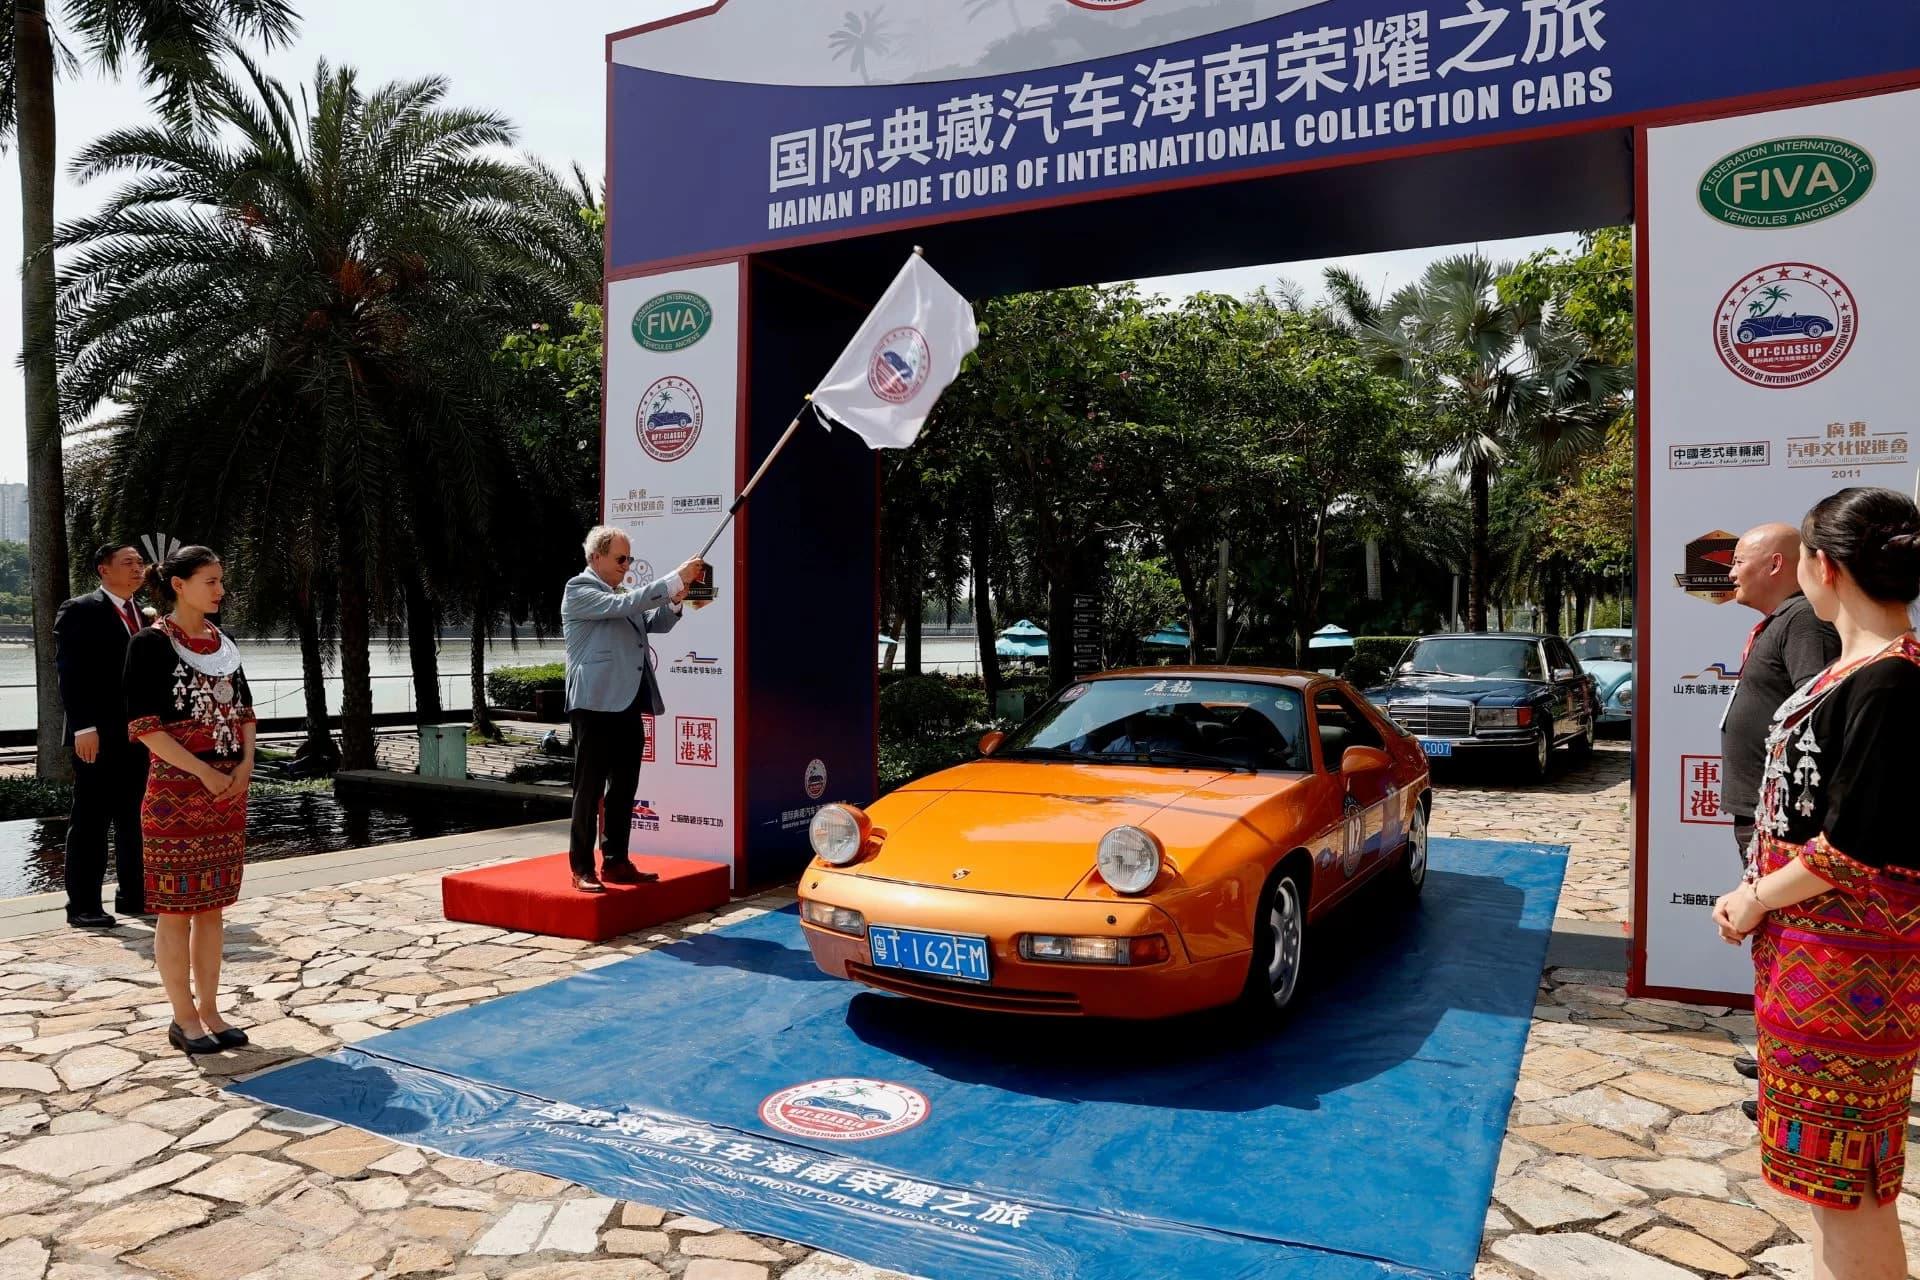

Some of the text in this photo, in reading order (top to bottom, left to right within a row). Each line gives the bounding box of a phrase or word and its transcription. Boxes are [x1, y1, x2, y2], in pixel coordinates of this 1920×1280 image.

[769, 0, 1606, 193] 国际典藏汽车海南荣耀之旅
[768, 66, 1613, 230] HAINAN PRIDE TOUR OF INTERNATIONAL COLLECTION CARS
[1703, 140, 1870, 192] FEDERATION INTERNATIONALE
[1733, 161, 1839, 204] FIVA
[1723, 196, 1848, 225] VEHICULES ANCIENS
[647, 308, 697, 336] FIVA
[1737, 363, 1754, 377] TOUR
[1764, 366, 1820, 384] INTERNATIONAL
[1819, 334, 1849, 370] COLLECTION
[1748, 343, 1822, 358] HPT-CLASSIC
[1831, 470, 1861, 478] 2011
[1673, 684, 1737, 695] 山东临清老
[1690, 761, 1721, 816] 車港
[812, 1191, 929, 1221] COLLECTION
[926, 1217, 979, 1234] CARS
